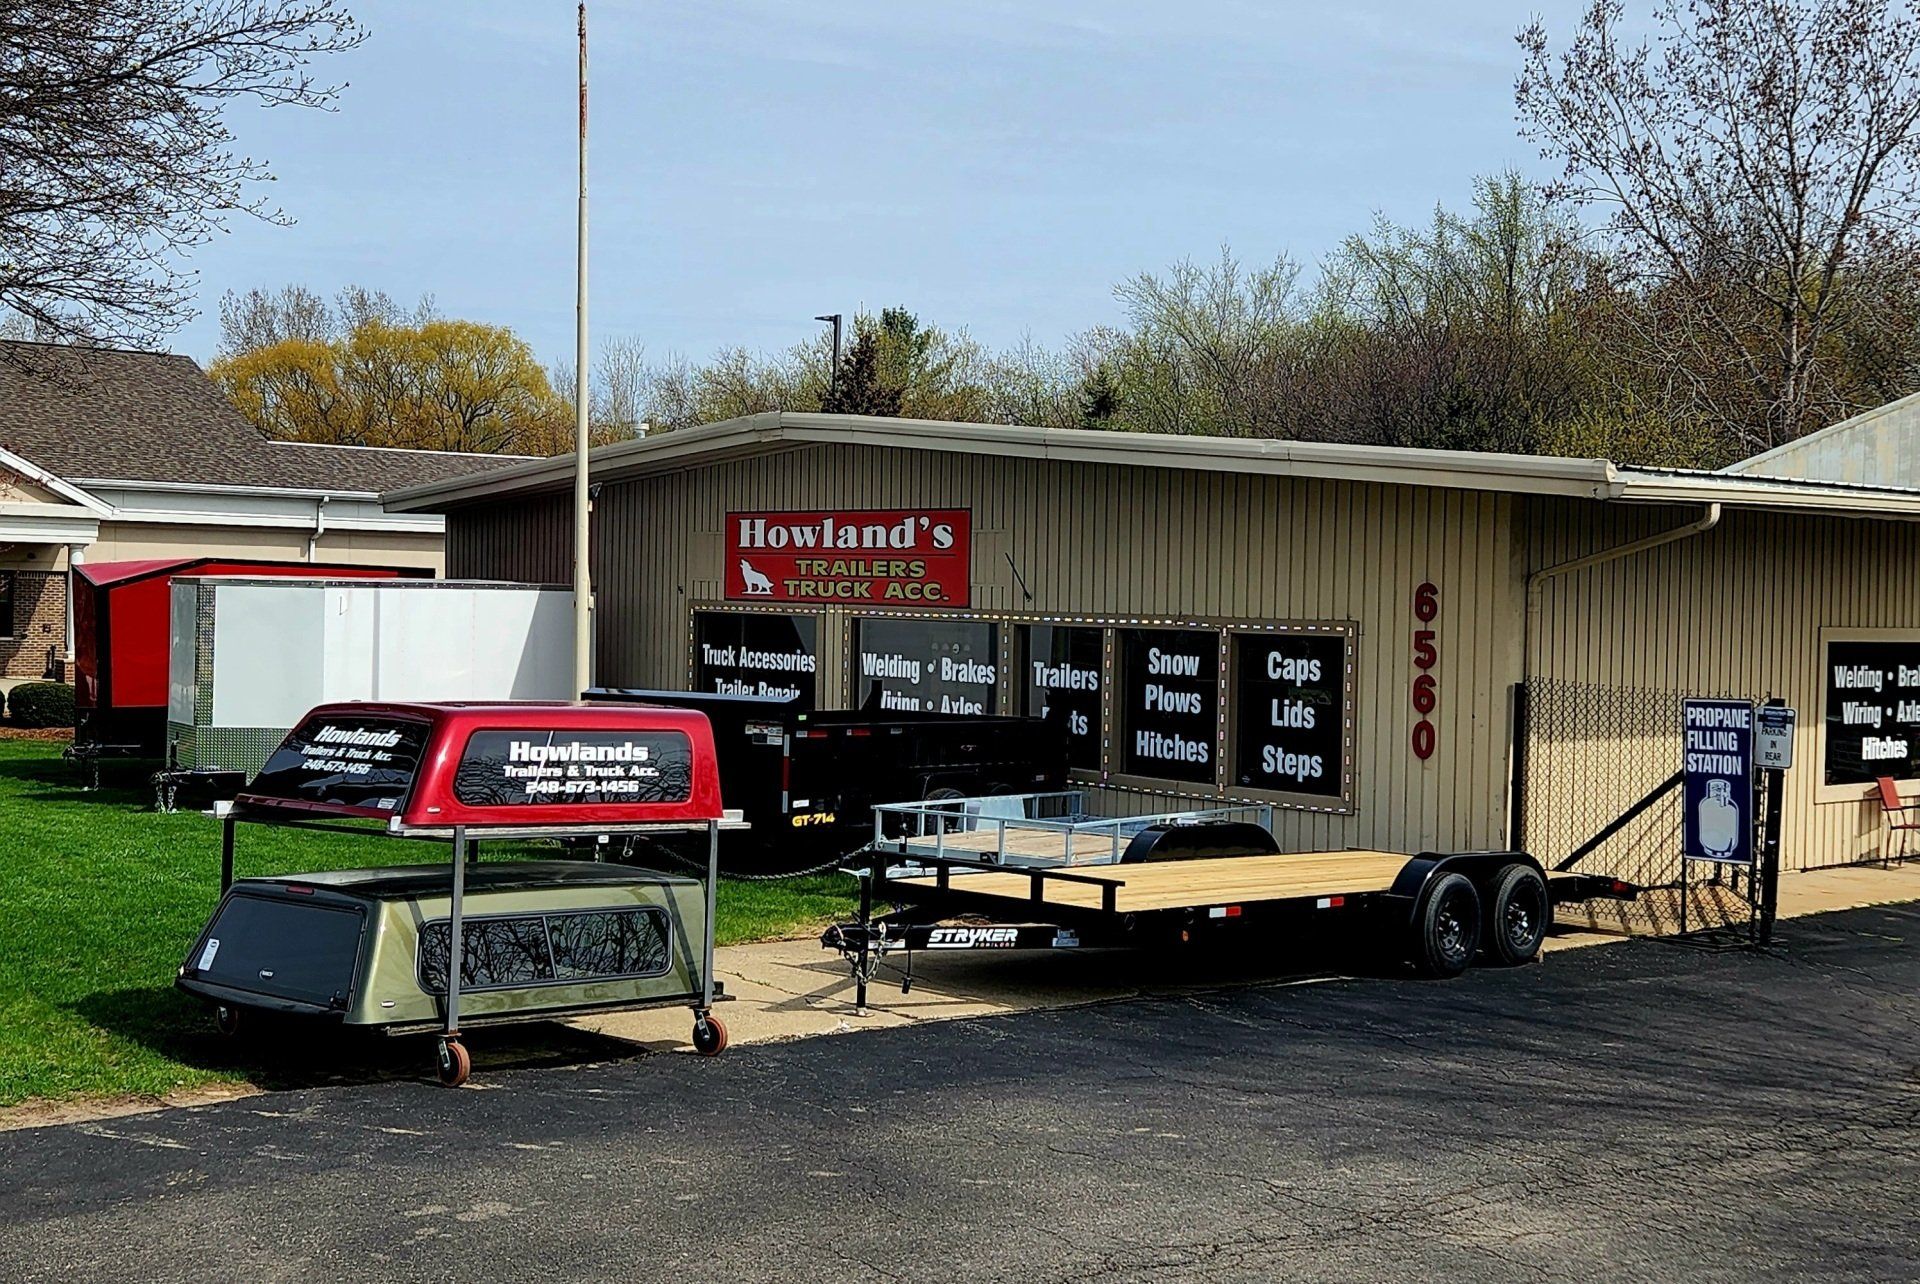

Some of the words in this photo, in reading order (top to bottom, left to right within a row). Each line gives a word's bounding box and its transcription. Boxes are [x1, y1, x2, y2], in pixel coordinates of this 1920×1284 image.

[738, 516, 954, 549] Howland's
[795, 559, 926, 578] TRAILERS
[783, 579, 873, 598] TRUCK
[884, 581, 950, 601] ACC.
[703, 643, 736, 667] Truck
[739, 646, 816, 672] Accessories
[861, 652, 921, 684] Welding
[941, 657, 996, 685] Brakes
[1148, 647, 1200, 676] Snow
[1033, 661, 1098, 691] Trailers
[1267, 651, 1322, 687] Caps
[1412, 582, 1438, 760] 6560
[1834, 665, 1883, 692] Welding
[1898, 665, 1920, 687] Bra
[715, 677, 755, 696] Trailer
[940, 694, 983, 715] Axles
[1145, 684, 1202, 714] Plows
[1271, 698, 1315, 729] Lids
[1686, 707, 1750, 728] PROPANE
[1842, 700, 1882, 728] Wiring
[313, 725, 402, 747] Howlands
[1136, 730, 1209, 763] Hitches
[1687, 730, 1738, 751] FILLING
[1770, 740, 1777, 749] IN
[301, 744, 335, 757] Trailers
[335, 748, 346, 758] &
[346, 748, 372, 760] Truck
[372, 751, 392, 761] Acc.
[509, 741, 649, 762] Howlands
[1764, 751, 1781, 761] REAR
[1862, 736, 1908, 760] Hitches
[301, 758, 373, 775] 248-673-1456
[503, 765, 563, 778] Trailers
[567, 765, 580, 777] &
[584, 765, 625, 777] Truck
[628, 765, 660, 777] Acc.
[1262, 744, 1323, 782] Steps
[1687, 753, 1742, 775] STATION
[525, 780, 640, 794] 248-673-1456
[792, 812, 836, 827] GT-714
[927, 928, 1018, 947] STRYKER
